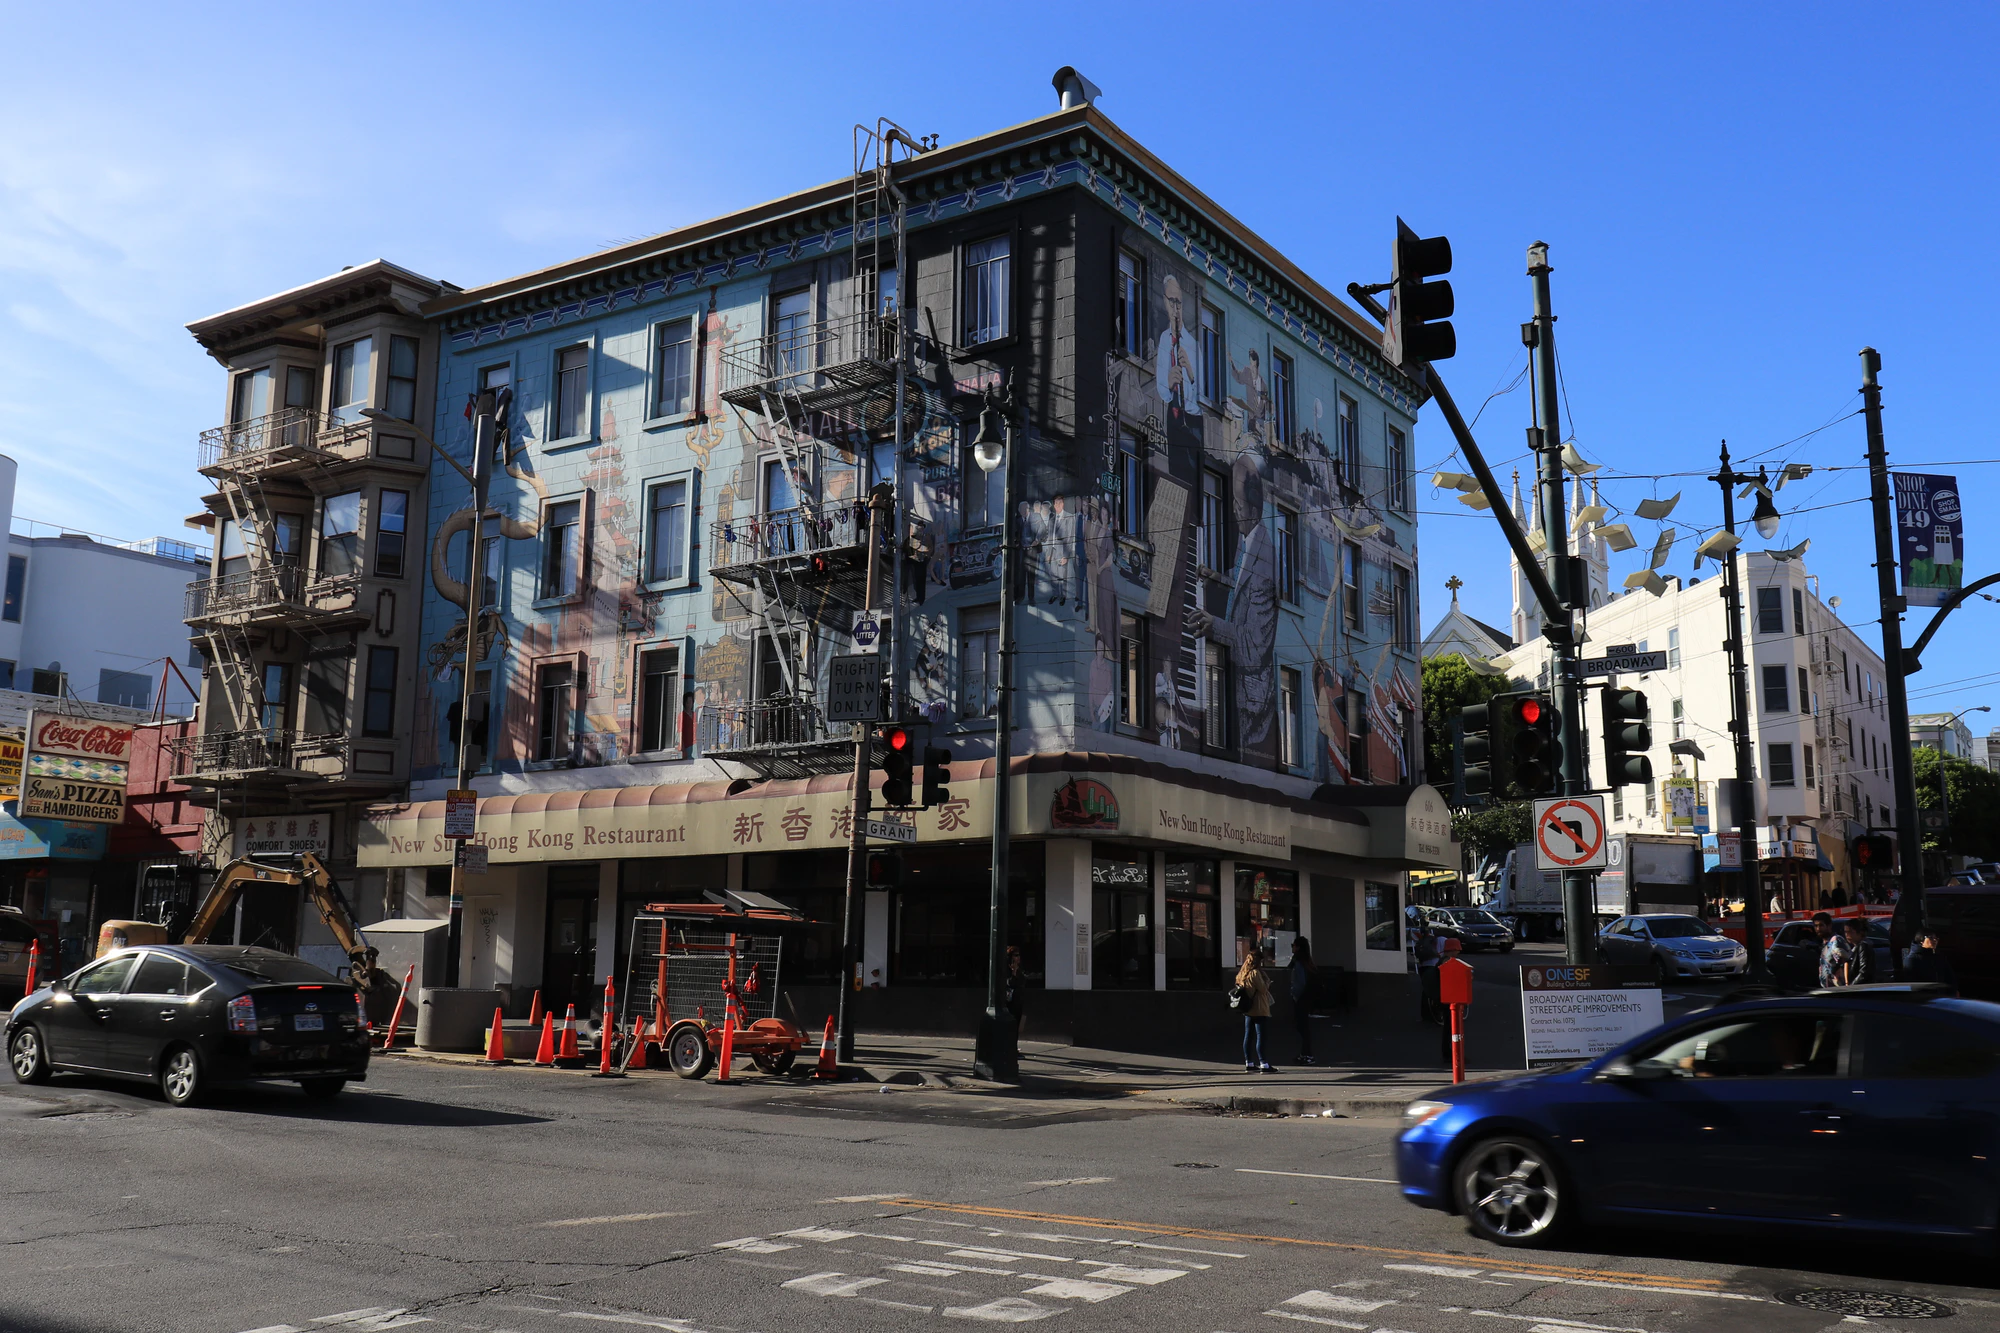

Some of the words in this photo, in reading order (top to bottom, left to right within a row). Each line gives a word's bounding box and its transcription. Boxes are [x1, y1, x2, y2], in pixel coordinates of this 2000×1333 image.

[1897, 476, 1925, 492] SHOP
[1899, 492, 1929, 510] DINE
[1938, 499, 1956, 507] SHOP
[1938, 504, 1960, 514] SMALL
[1899, 510, 1930, 528] 49
[856, 631, 876, 640] LITTER
[1616, 646, 1633, 654] 600
[835, 662, 875, 677] RIGHT
[1588, 655, 1657, 672] BROADWAY
[836, 681, 875, 695] TURN
[834, 701, 873, 713] ONLY
[28, 779, 60, 801] Sam's
[61, 784, 124, 807] PIZZA
[44, 801, 119, 820] HAMBURGERS
[871, 823, 913, 840] GRANT
[1160, 809, 1179, 829] New
[1181, 814, 1197, 832] Sun
[1200, 818, 1222, 840] Hong
[1224, 822, 1244, 844] Kong
[1246, 826, 1285, 847] Restaurant
[246, 840, 284, 851] COMFORT
[289, 840, 315, 850] SHOES
[390, 836, 425, 853] New
[433, 834, 453, 852] Su
[474, 832, 518, 853] Hong
[527, 829, 573, 850] Kong
[584, 825, 686, 846] Restaurant
[1794, 844, 1816, 856] Liquor
[112, 936, 127, 946] CAT
[1546, 968, 1591, 981] ONESF
[1529, 995, 1574, 1004] BROADWAY
[1576, 994, 1627, 1003] CHINATOWN
[1529, 1005, 1582, 1014] STREETSCAPE
[1583, 1003, 1642, 1013] IMPROVEMENTS
